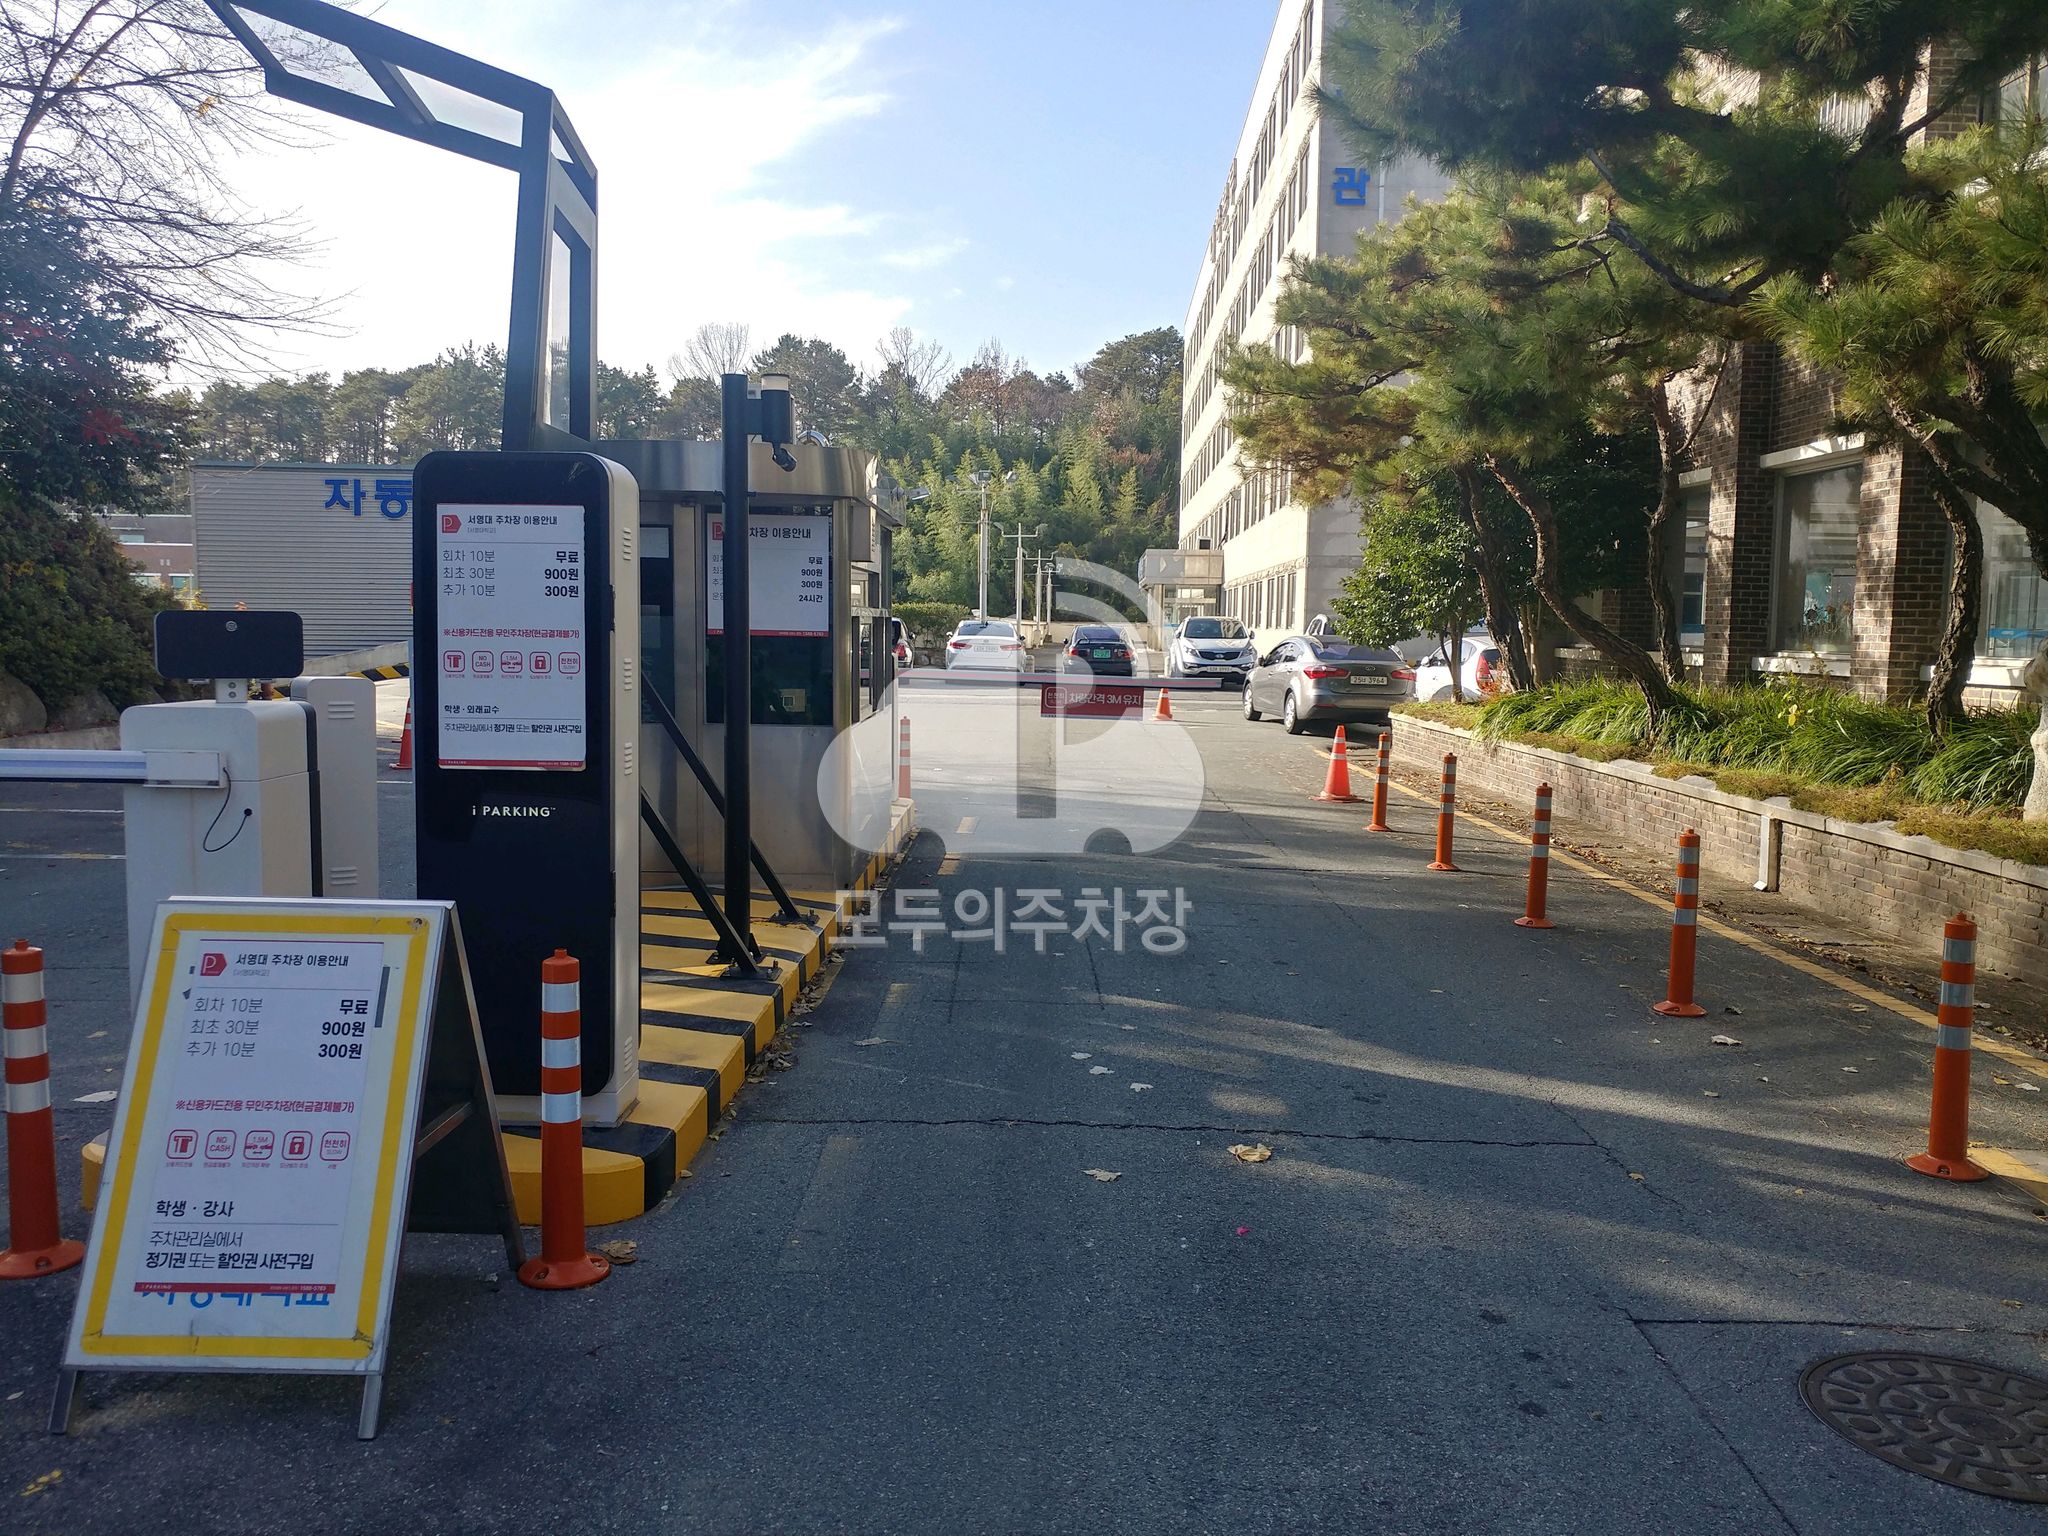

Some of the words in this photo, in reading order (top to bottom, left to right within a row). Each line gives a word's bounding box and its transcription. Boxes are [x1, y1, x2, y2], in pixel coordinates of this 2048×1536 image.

[1332, 167, 1370, 206] 관
[324, 479, 413, 519] 자동
[467, 515, 493, 525] 서영대
[496, 515, 521, 525] 주차장
[524, 516, 558, 526] 이용안내
[749, 526, 768, 538] 차장
[772, 528, 812, 539] 이용안내
[443, 550, 466, 562] 회차
[470, 550, 496, 562] 10분
[556, 551, 579, 564] 무료
[808, 556, 823, 565] 무료
[443, 568, 466, 579] 최초
[469, 568, 496, 580] 30분
[544, 568, 579, 581] 900원
[801, 568, 823, 577] 900원
[443, 584, 466, 596] 추가
[470, 584, 496, 596] 10분
[801, 580, 823, 588] 300원
[544, 586, 579, 598] 300원
[798, 594, 824, 603] 24시간
[1070, 693, 1106, 704] 차량간격
[1106, 694, 1121, 704] 3M
[1122, 695, 1141, 705] 유지
[444, 705, 460, 714] 학생
[466, 705, 500, 714] 외래교수
[494, 724, 514, 733] 정기권
[516, 725, 530, 733] 또는
[531, 725, 552, 734] 할인권
[554, 725, 582, 734] 사전구입
[236, 954, 268, 965] 서영대
[271, 954, 304, 966] 주차장
[306, 955, 350, 966] 이용안내
[194, 998, 224, 1014] 회차
[230, 998, 263, 1014] 10분
[339, 1000, 369, 1016] 무료
[190, 1020, 220, 1036] 최초
[225, 1020, 260, 1036] 30분
[322, 1022, 366, 1038] 900원
[186, 1041, 216, 1057] 추가
[222, 1042, 256, 1058] 10분
[318, 1044, 362, 1060] 300원
[210, 1144, 232, 1152] CASH
[156, 1200, 186, 1217] 학생
[204, 1200, 234, 1217] 강사
[150, 1230, 244, 1248] 주차관리실에서
[146, 1252, 187, 1268] 정기권
[188, 1253, 216, 1268] 또는
[218, 1252, 259, 1270] 할인권
[260, 1254, 314, 1270] 사전구입
